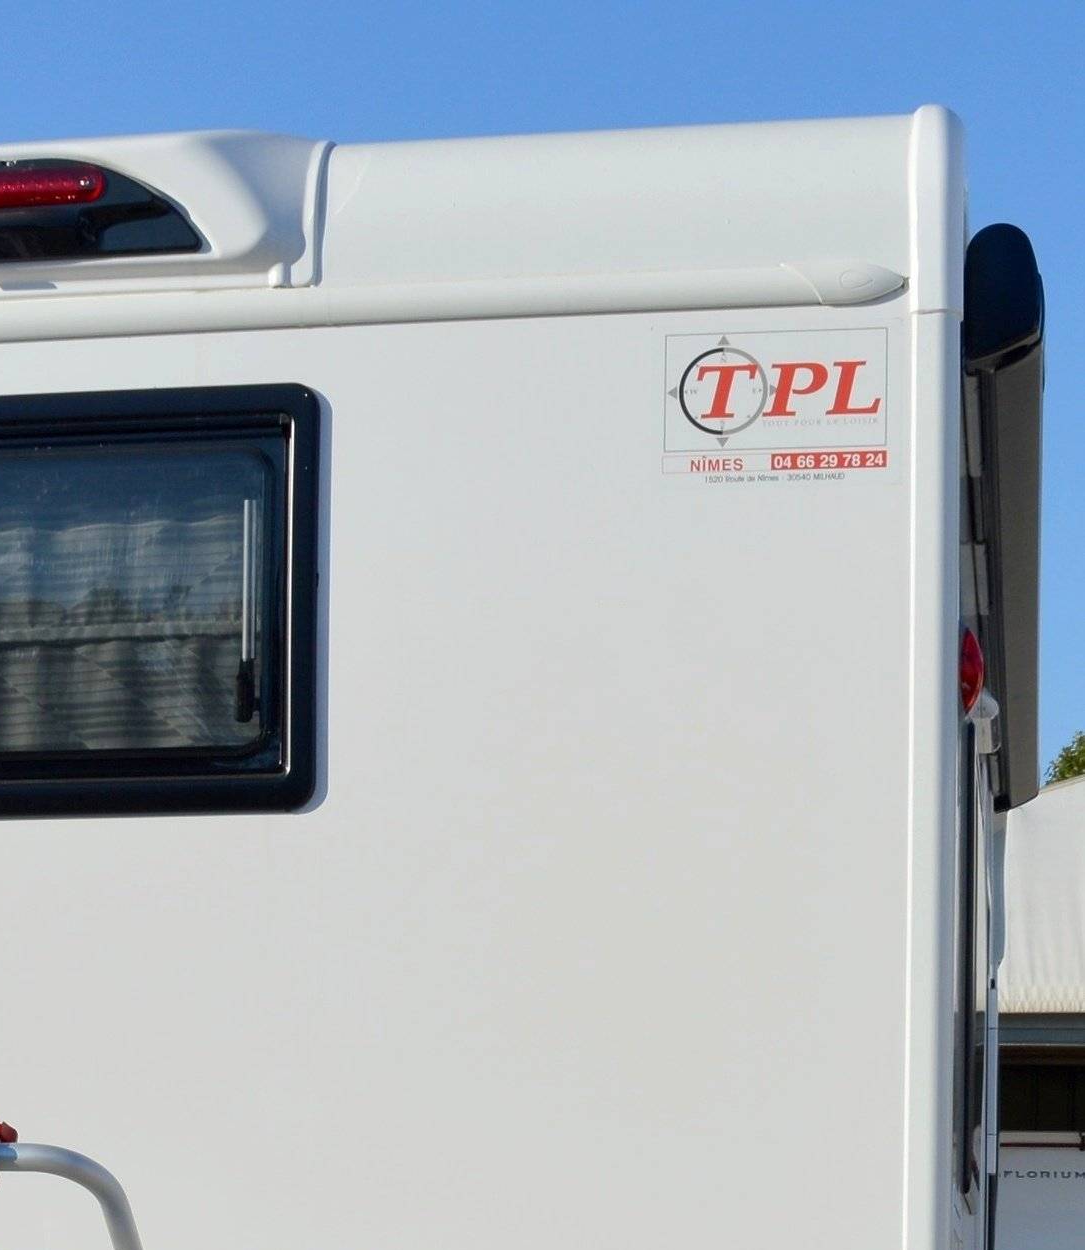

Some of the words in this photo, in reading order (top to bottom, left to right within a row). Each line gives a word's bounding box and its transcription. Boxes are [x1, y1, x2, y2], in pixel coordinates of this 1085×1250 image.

[696, 360, 882, 419] TPL
[690, 455, 744, 473] NÎMES
[774, 455, 793, 469] 04
[796, 454, 815, 468] 66
[819, 454, 839, 467] 29
[842, 453, 861, 467] 78
[865, 452, 884, 466] 24
[1003, 1170, 1085, 1179] FLORIUM
